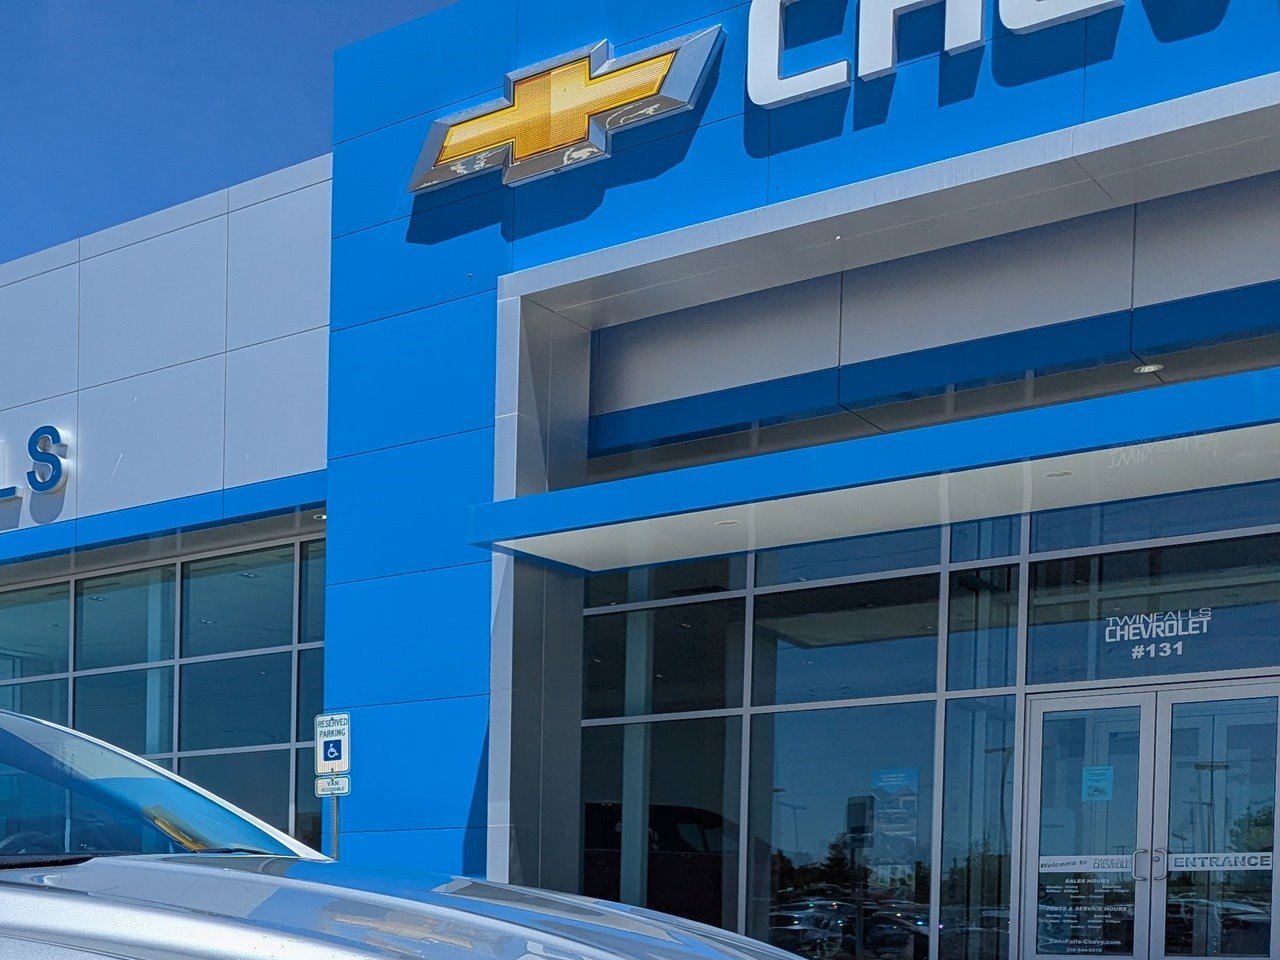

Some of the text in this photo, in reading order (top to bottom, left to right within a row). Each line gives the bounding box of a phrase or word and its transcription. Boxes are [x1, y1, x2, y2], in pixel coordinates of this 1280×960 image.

[1105, 617, 1212, 642] CHEVROLET
[1131, 641, 1183, 659] #131
[318, 718, 348, 728] RESERVED
[319, 729, 346, 738] PARKING
[1040, 861, 1076, 869] Welcome
[1174, 855, 1271, 868] ENTRANCE
